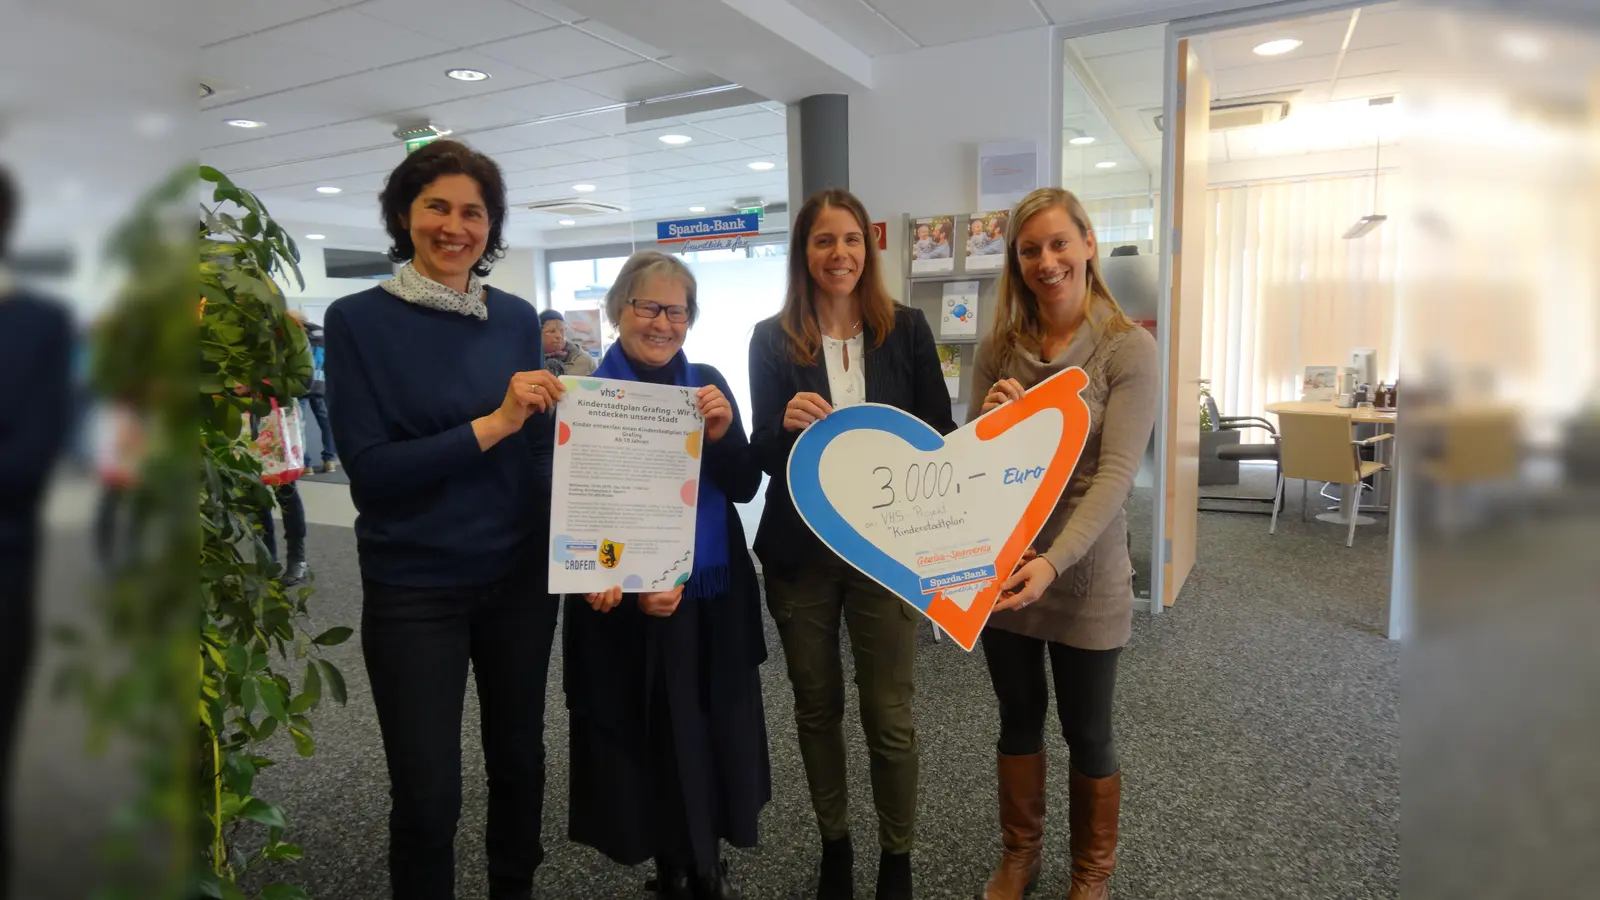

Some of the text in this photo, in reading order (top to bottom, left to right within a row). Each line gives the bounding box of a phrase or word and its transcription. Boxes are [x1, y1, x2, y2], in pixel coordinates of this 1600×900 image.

[668, 218, 746, 237] Sparda-Bank
[600, 388, 616, 398] vhs
[577, 399, 641, 413] Kinderstadtplan
[642, 405, 671, 416] Grafing
[677, 408, 690, 416] Wir
[588, 409, 629, 419] entdecken
[657, 415, 678, 423] Stadt
[638, 427, 682, 436] Kinderstadtplan
[1003, 466, 1045, 485] Euro
[565, 560, 596, 570] CADFEM
[930, 569, 988, 588] Sparda-Bank
